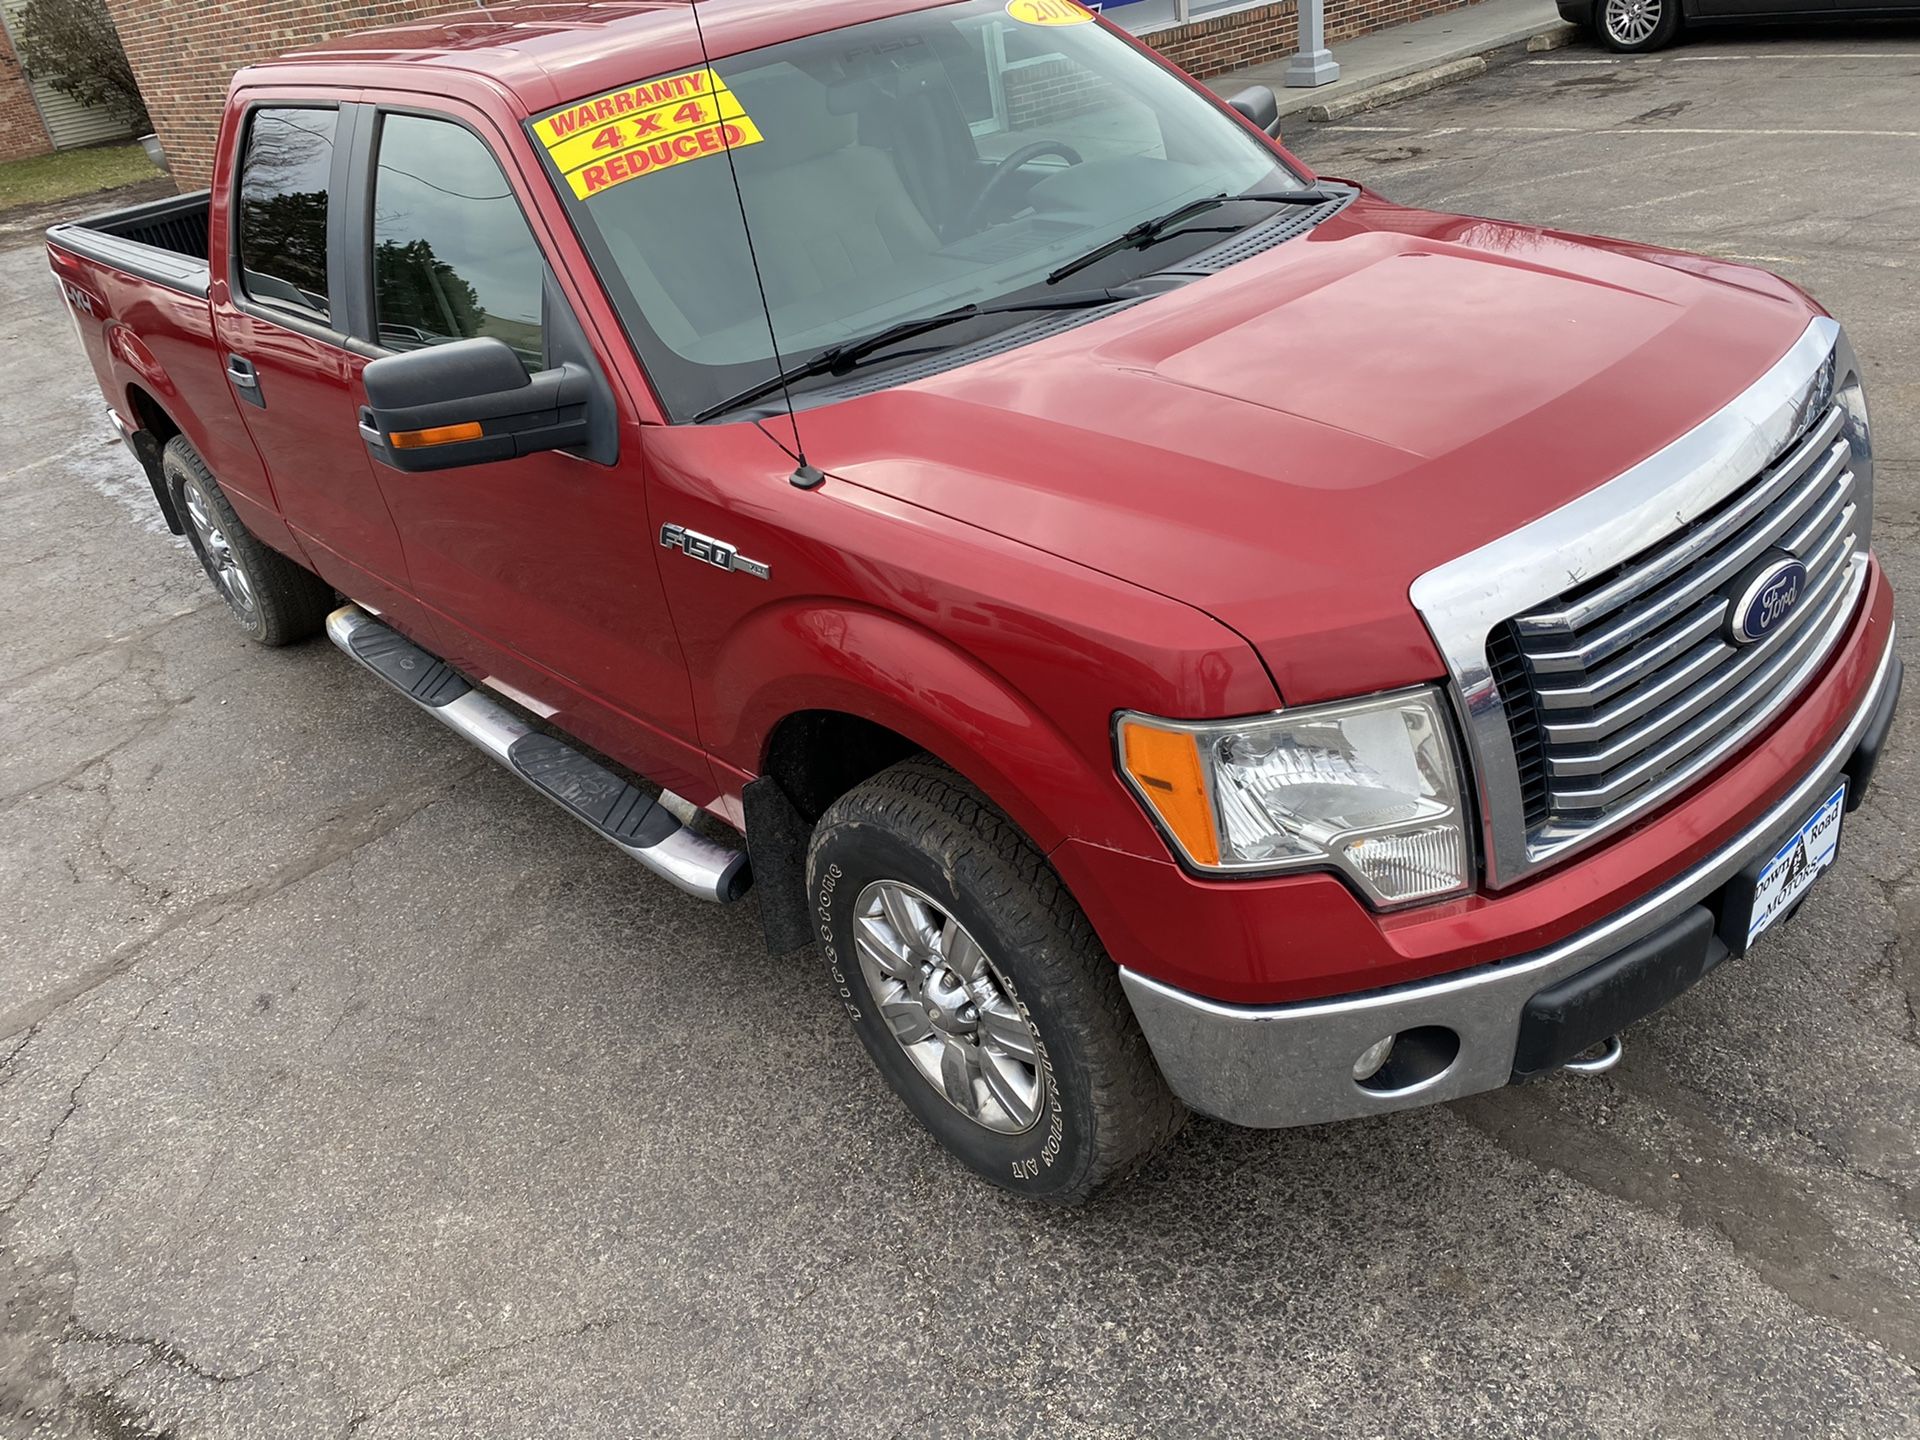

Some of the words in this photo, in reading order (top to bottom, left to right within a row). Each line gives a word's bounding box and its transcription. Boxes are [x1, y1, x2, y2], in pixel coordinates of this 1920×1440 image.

[549, 72, 705, 137] WARRANTY
[592, 125, 627, 150] 4
[673, 100, 708, 125] 4
[582, 123, 747, 192] REDUCED
[1760, 575, 1798, 628] Ford
[1754, 855, 1791, 901] Down
[1809, 801, 1840, 845] Road
[1764, 855, 1819, 919] MOTORS
[1012, 1156, 1039, 1180] A/T
